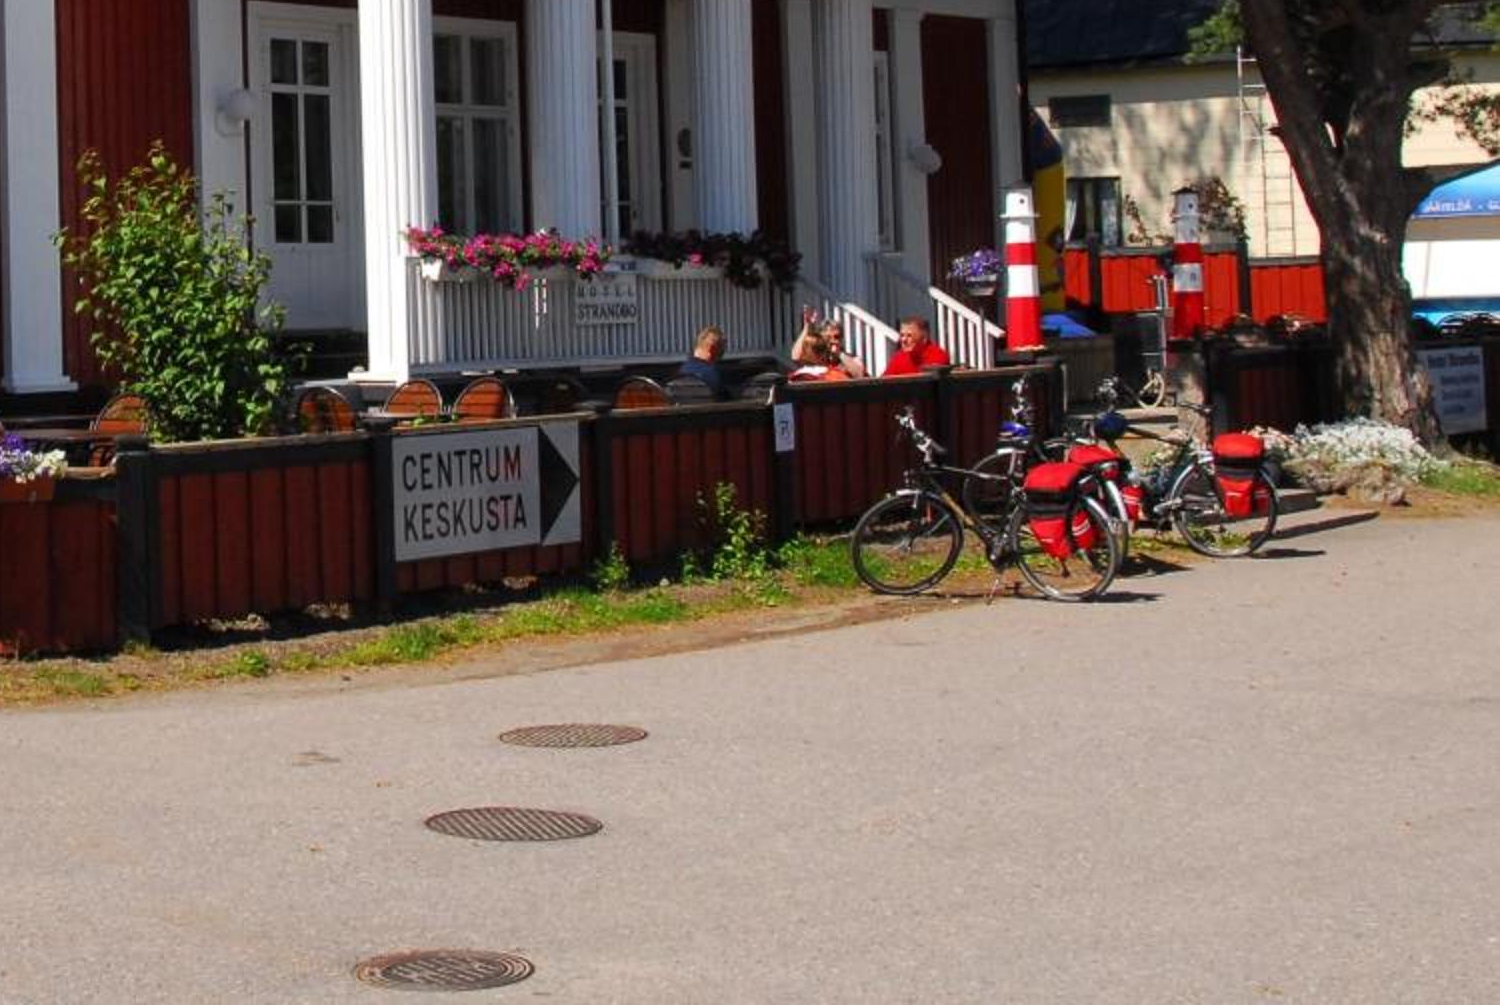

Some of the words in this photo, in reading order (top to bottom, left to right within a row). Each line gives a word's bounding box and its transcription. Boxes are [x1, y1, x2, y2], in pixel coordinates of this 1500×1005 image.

[578, 303, 637, 320] STRANDBO
[402, 445, 521, 491] CENTRUM
[403, 493, 527, 543] KESKUSTA
